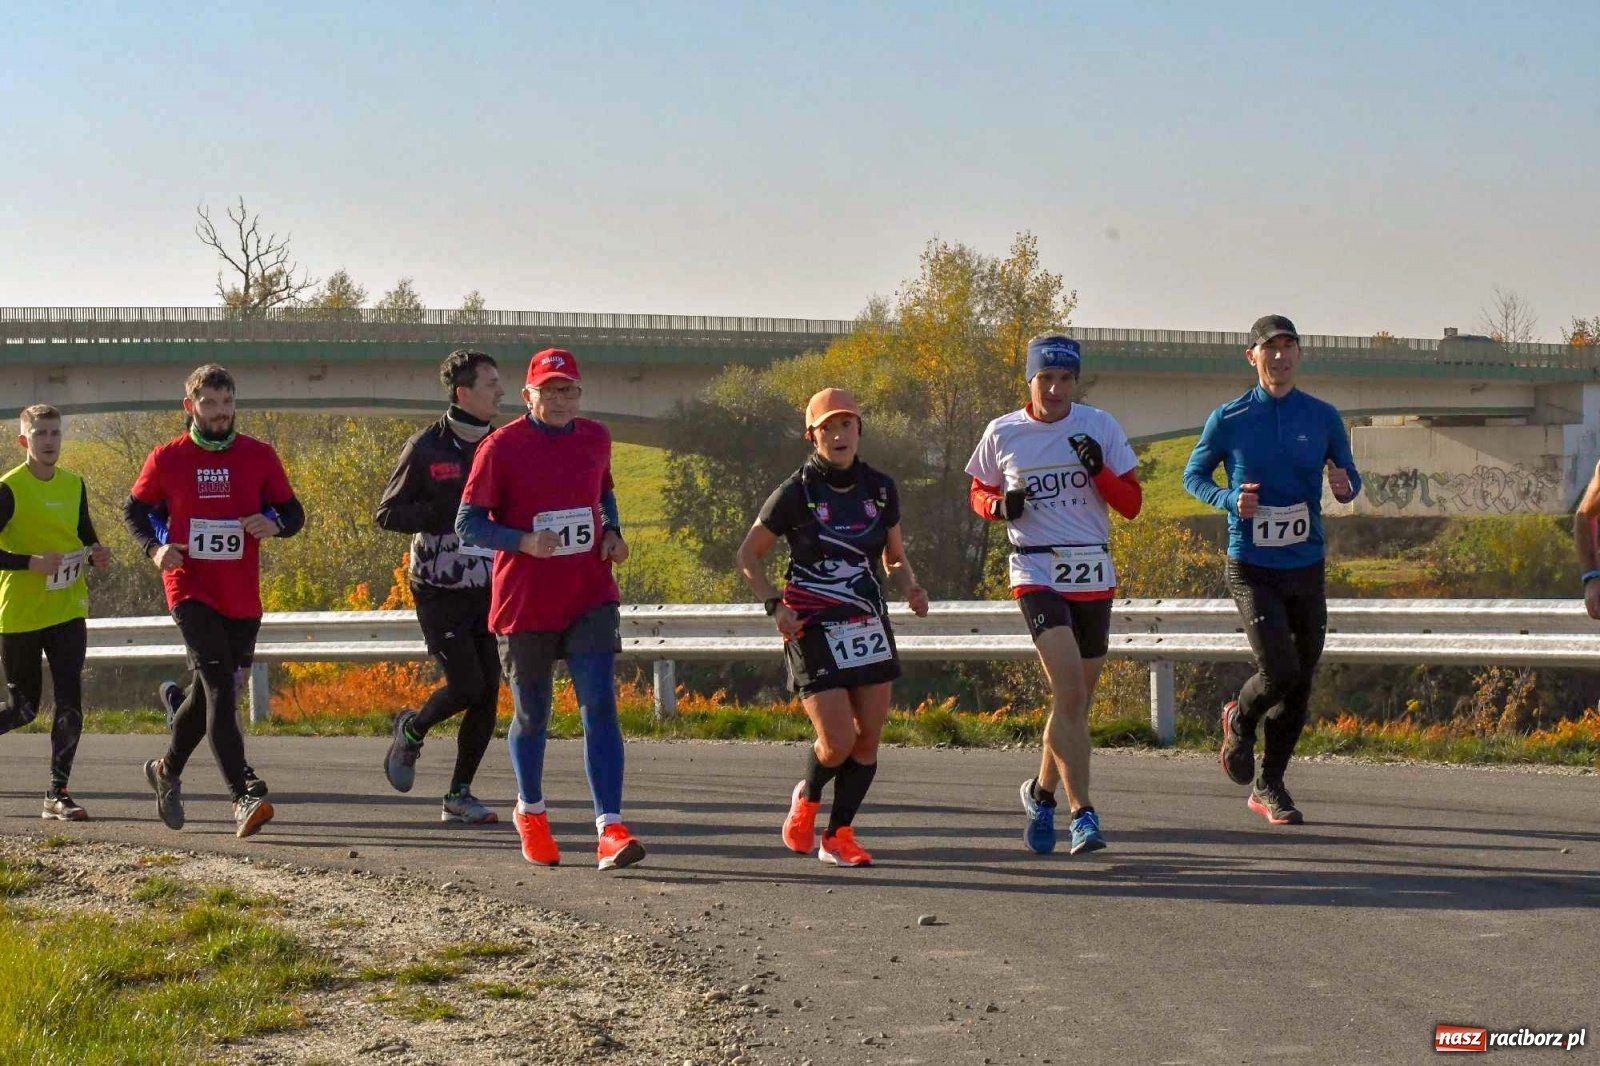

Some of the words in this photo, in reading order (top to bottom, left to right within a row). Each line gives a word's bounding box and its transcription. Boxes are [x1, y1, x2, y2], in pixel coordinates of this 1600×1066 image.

[198, 482, 230, 493] RUN
[1257, 519, 1306, 539] 170
[194, 534, 240, 552] 159
[1055, 562, 1103, 583] 221
[834, 633, 887, 660] 152
